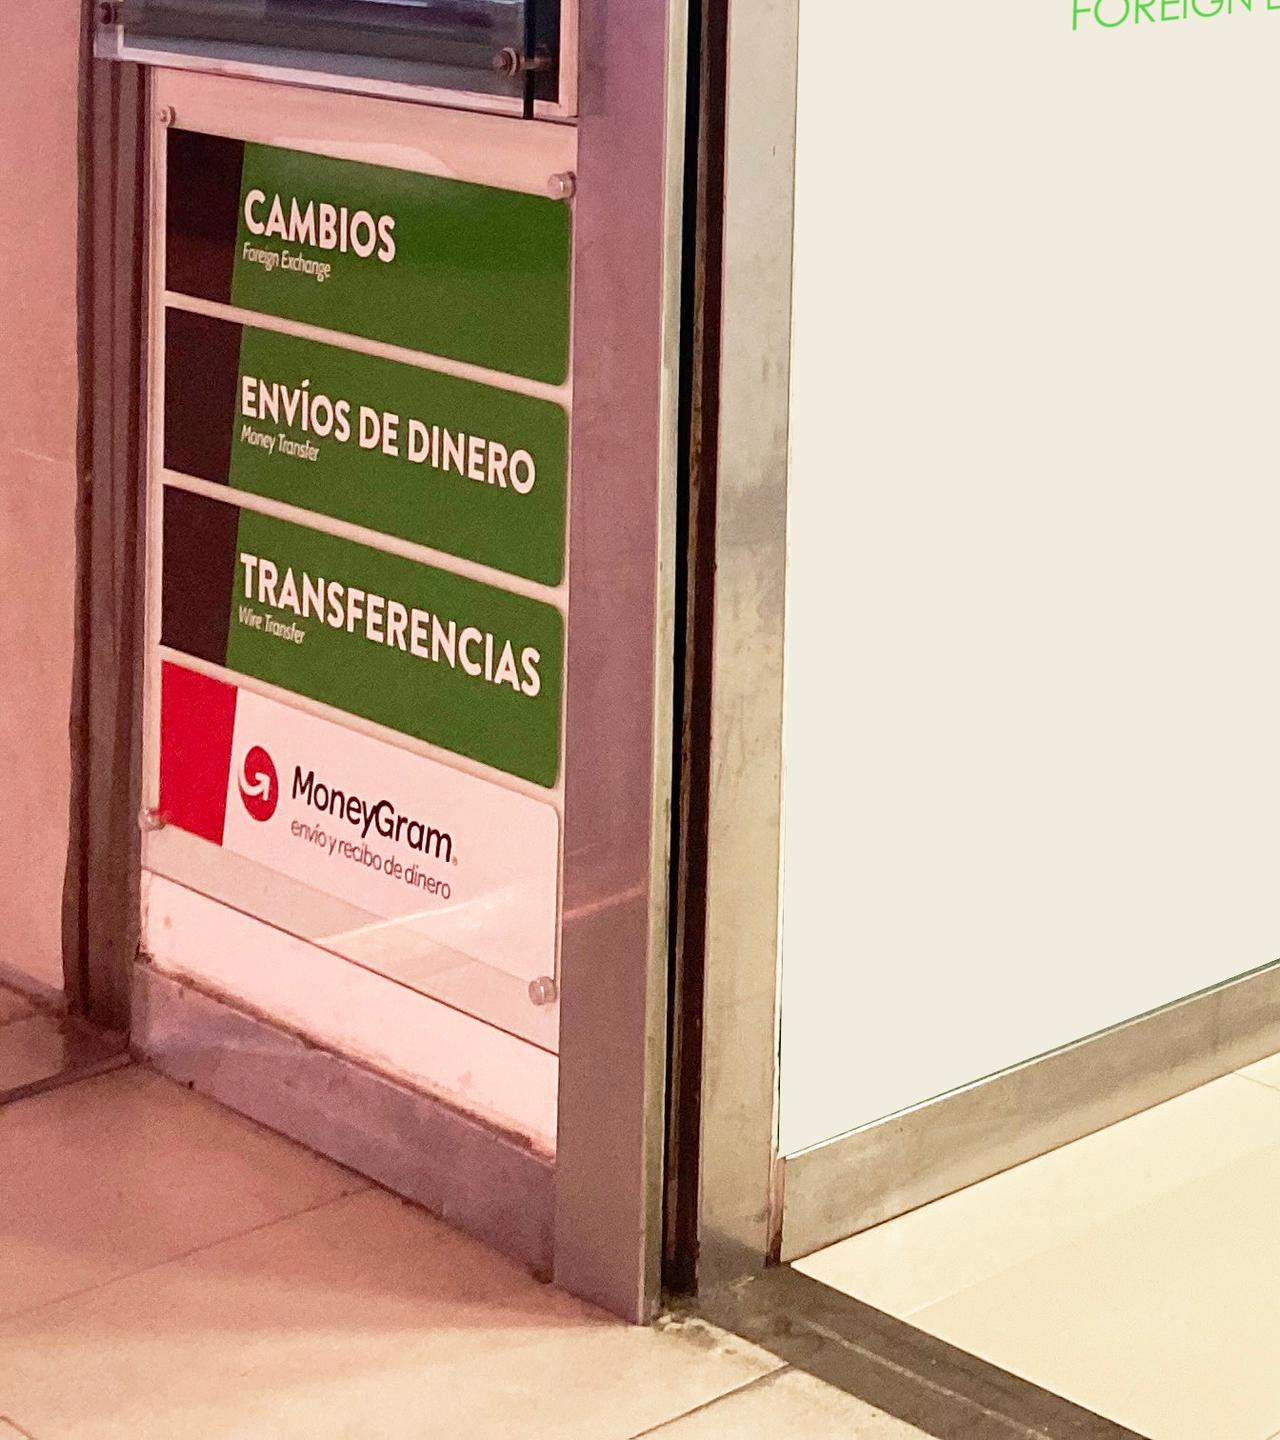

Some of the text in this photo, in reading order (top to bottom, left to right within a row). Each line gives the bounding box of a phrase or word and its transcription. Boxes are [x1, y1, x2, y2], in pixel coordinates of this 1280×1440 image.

[242, 241, 332, 282] Foreign Exchange
[243, 188, 397, 263] CAMBIOS
[241, 374, 537, 495] ENVÍOS DE DINERO
[241, 424, 320, 463] Money Transfer
[238, 605, 306, 646] Wire Transfer
[239, 552, 542, 698] TRANSFERENCIAS
[292, 765, 453, 863] MoneyGram
[291, 820, 452, 901] envío y recibo de dinero
